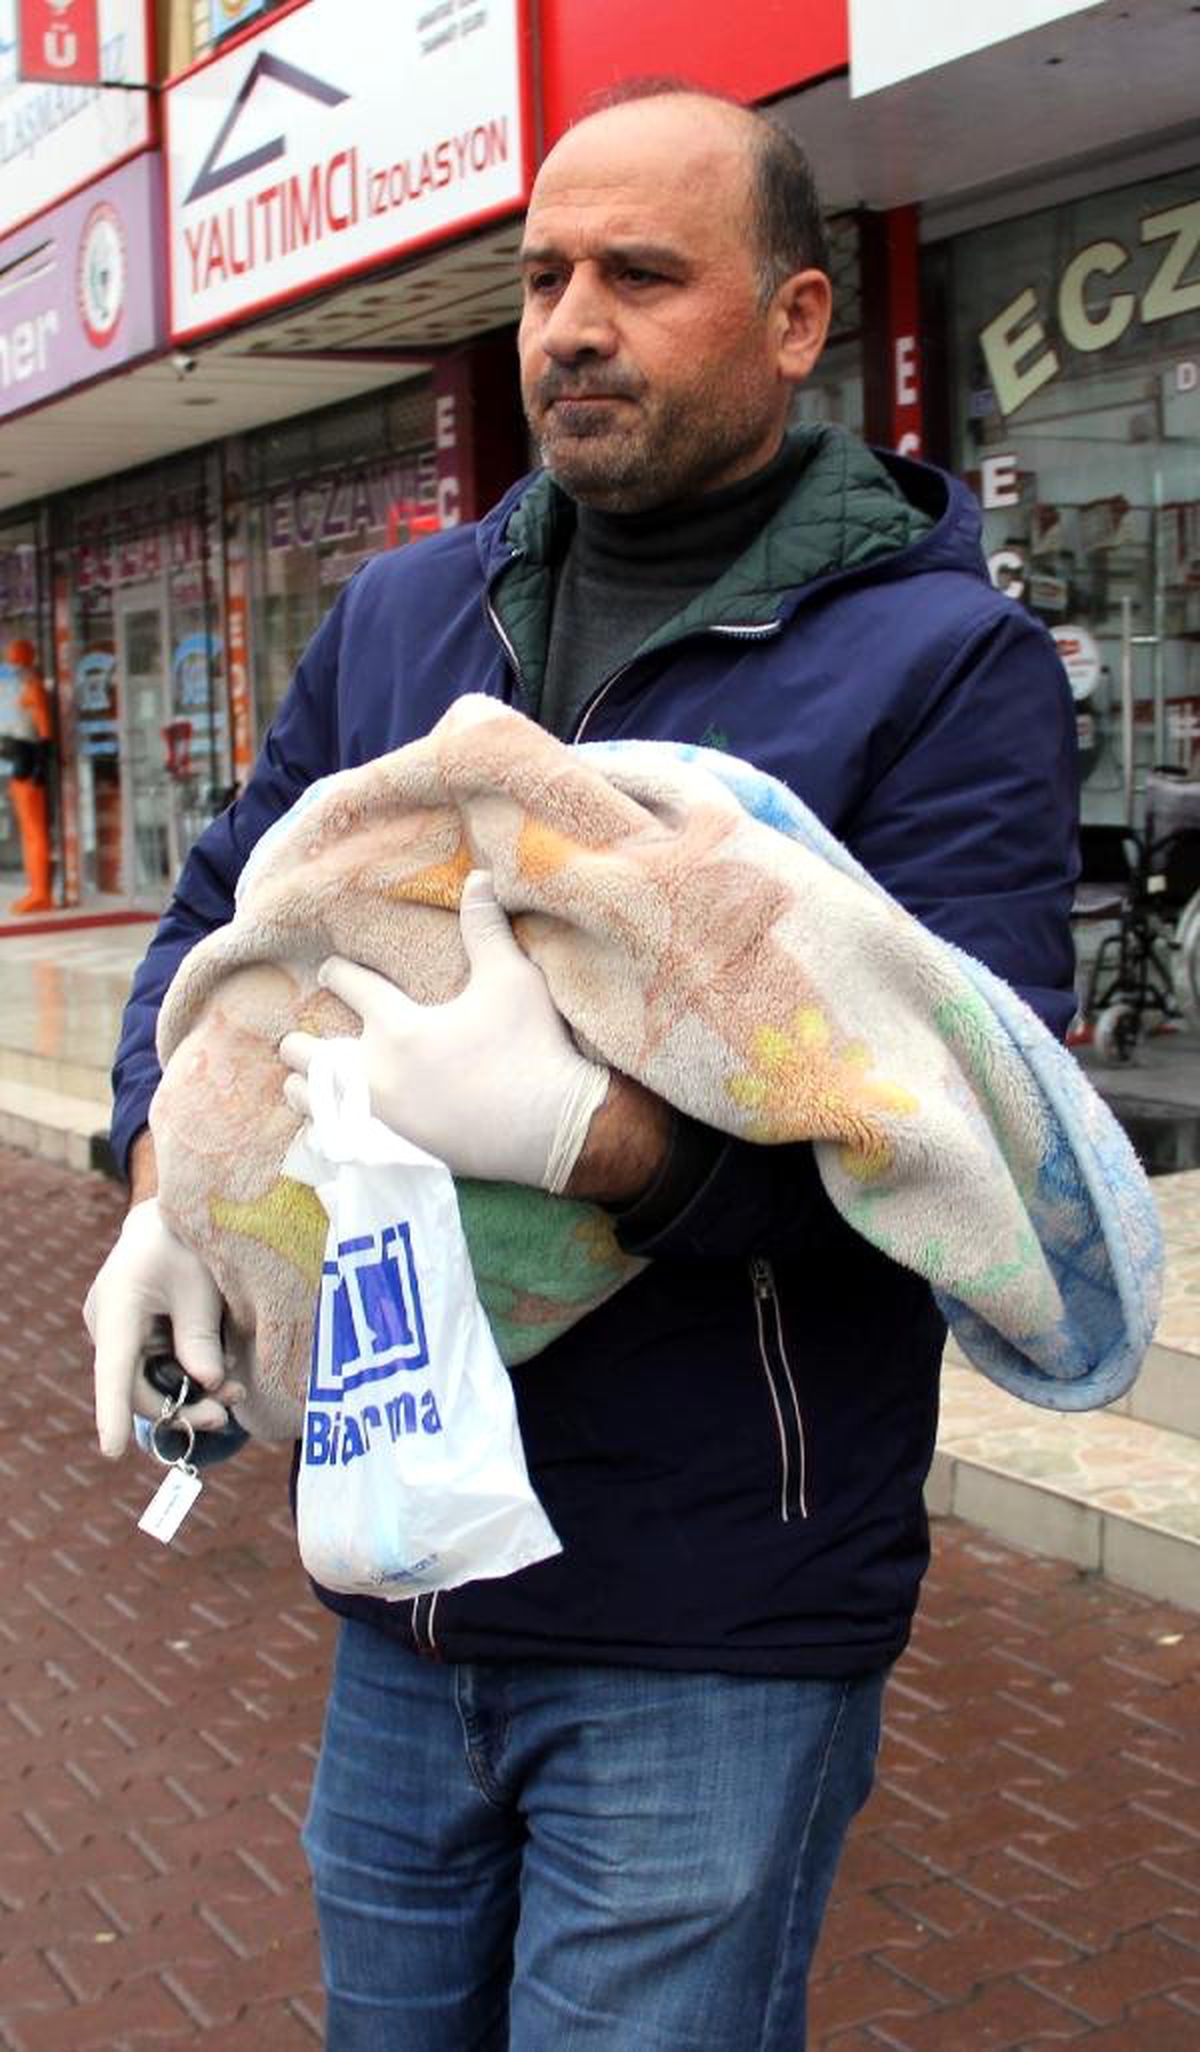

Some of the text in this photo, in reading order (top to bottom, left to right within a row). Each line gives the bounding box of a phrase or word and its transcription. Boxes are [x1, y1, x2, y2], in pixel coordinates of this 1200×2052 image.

[184, 146, 358, 294] YALITIMCI
[978, 198, 1200, 416] ECZ
[306, 1389, 443, 1466] Biarma
